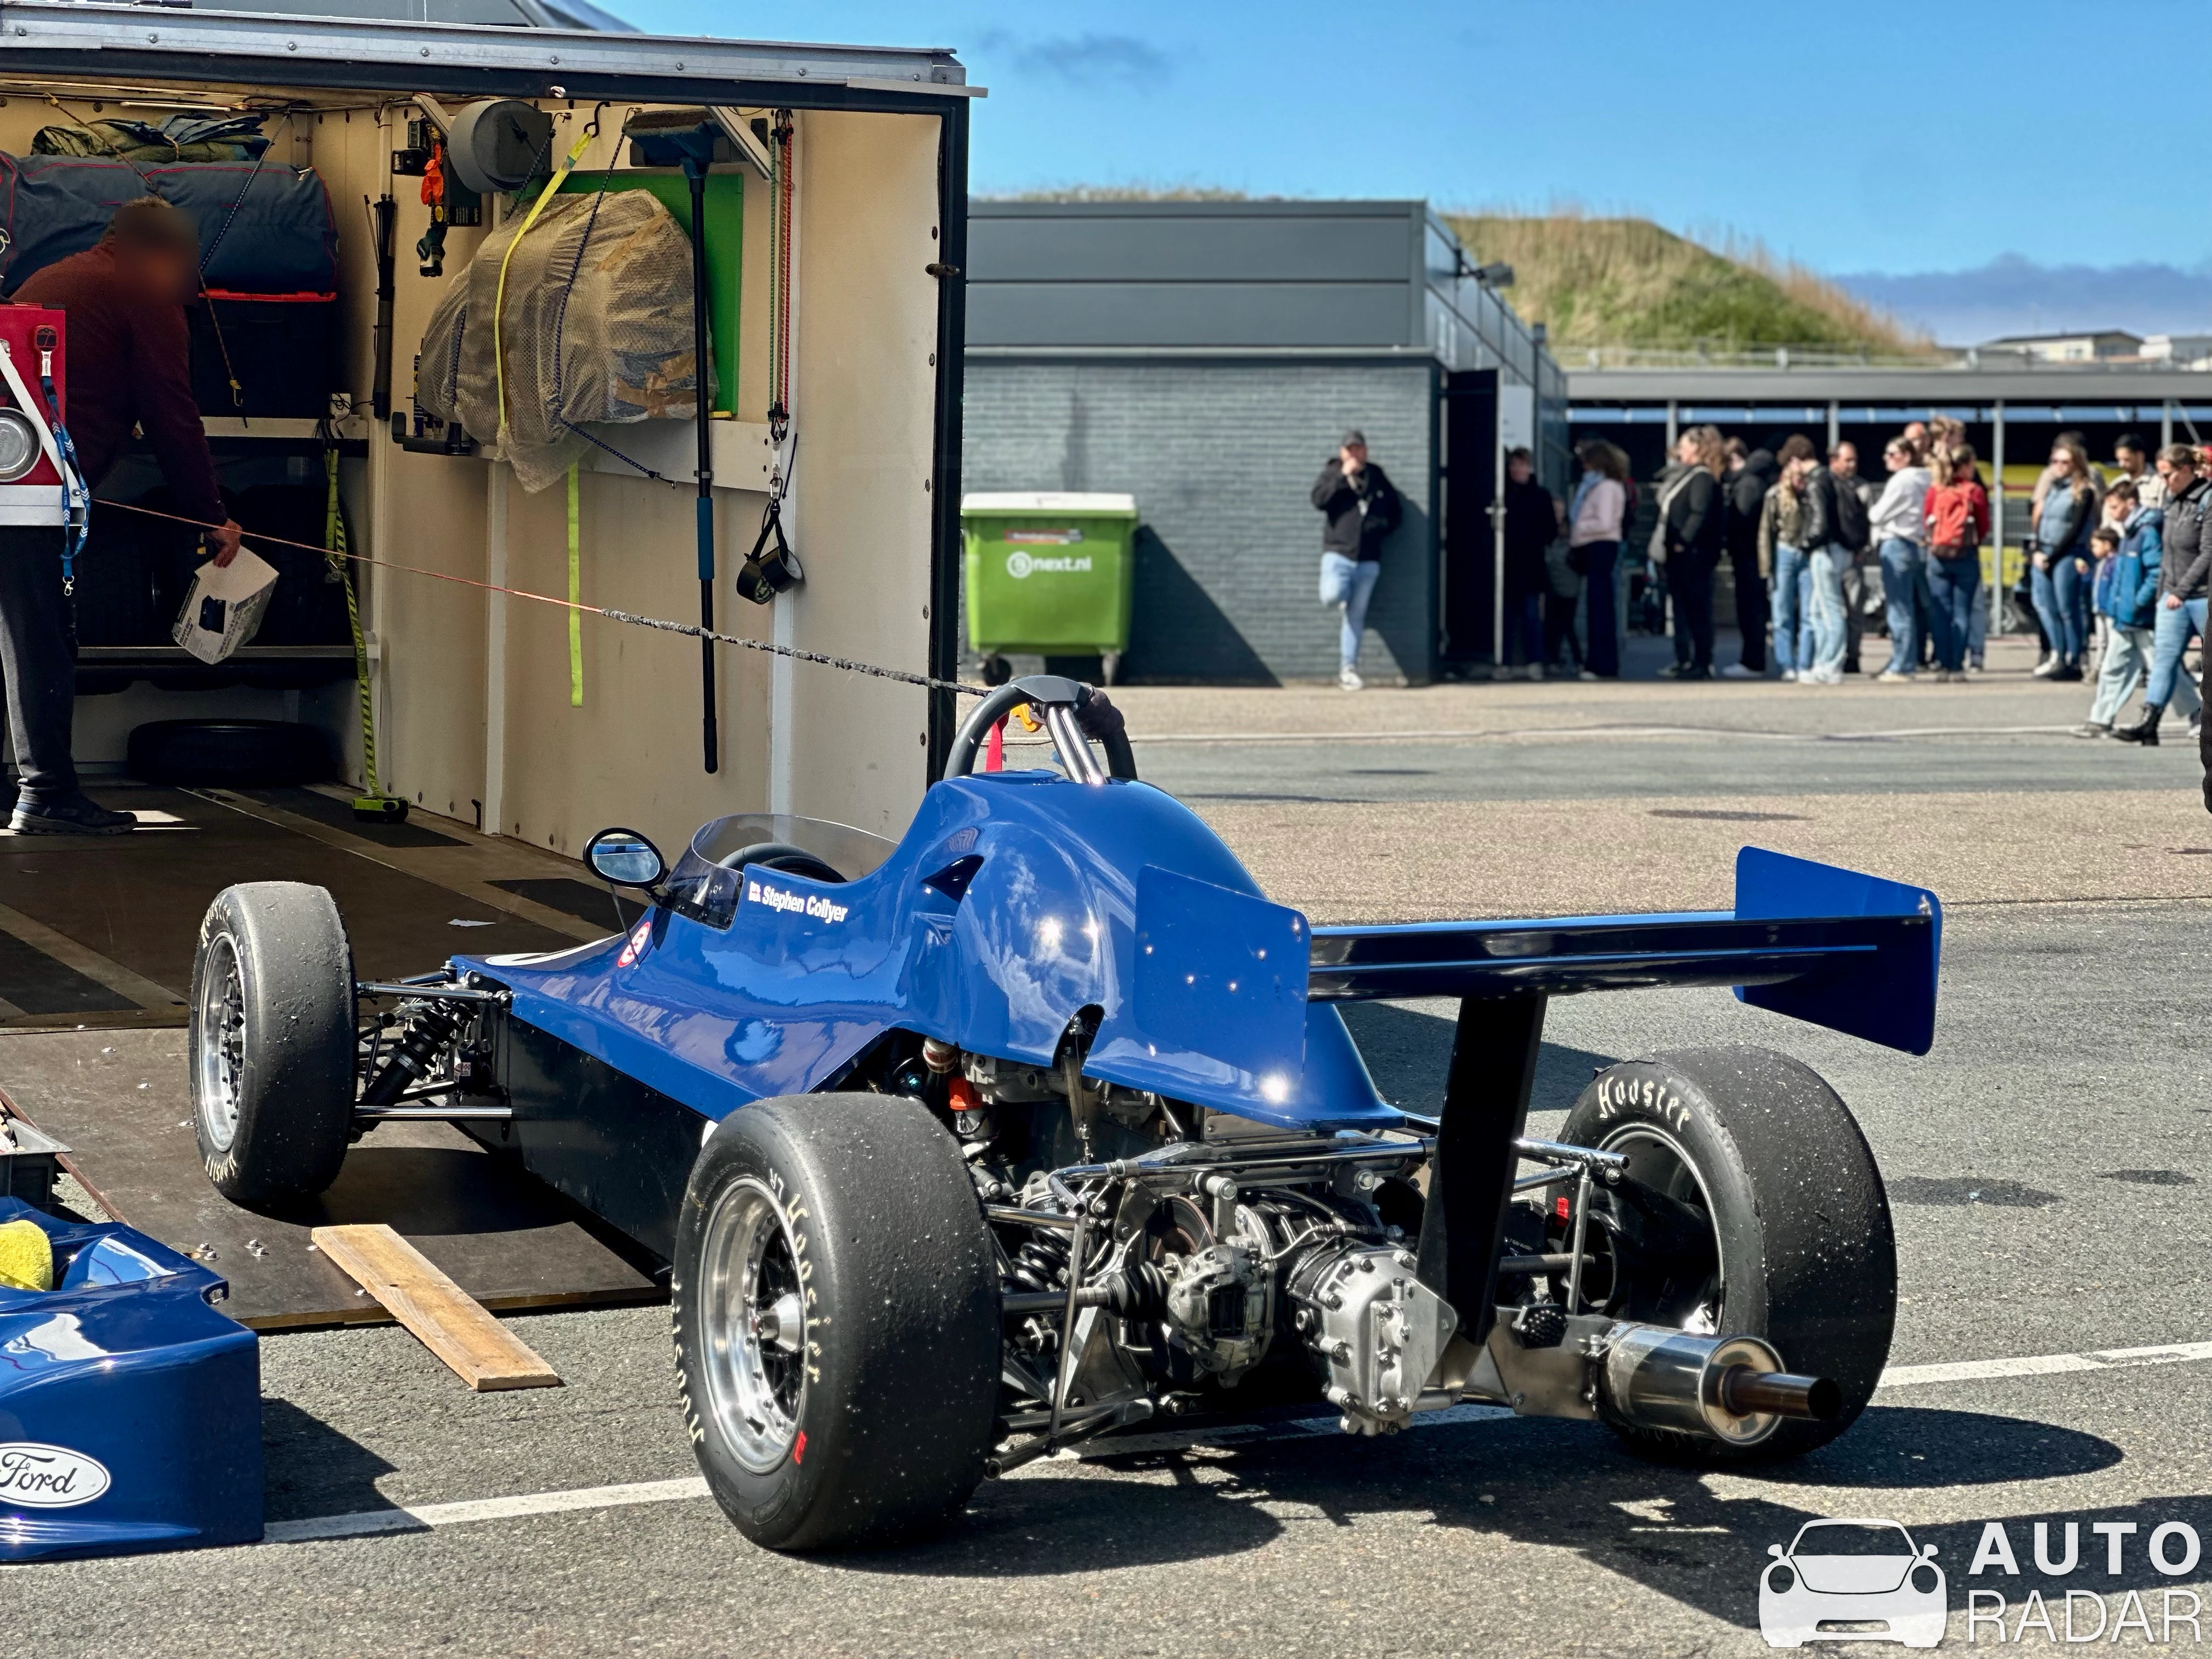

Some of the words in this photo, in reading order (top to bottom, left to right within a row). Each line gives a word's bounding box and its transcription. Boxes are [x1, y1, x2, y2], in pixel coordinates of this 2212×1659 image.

[763, 885, 804, 912] Stephen
[806, 895, 848, 924] Collyer
[1598, 1076, 1691, 1132] Hoosier
[787, 1193, 831, 1383] Hoosier
[0, 1452, 77, 1494] Ford
